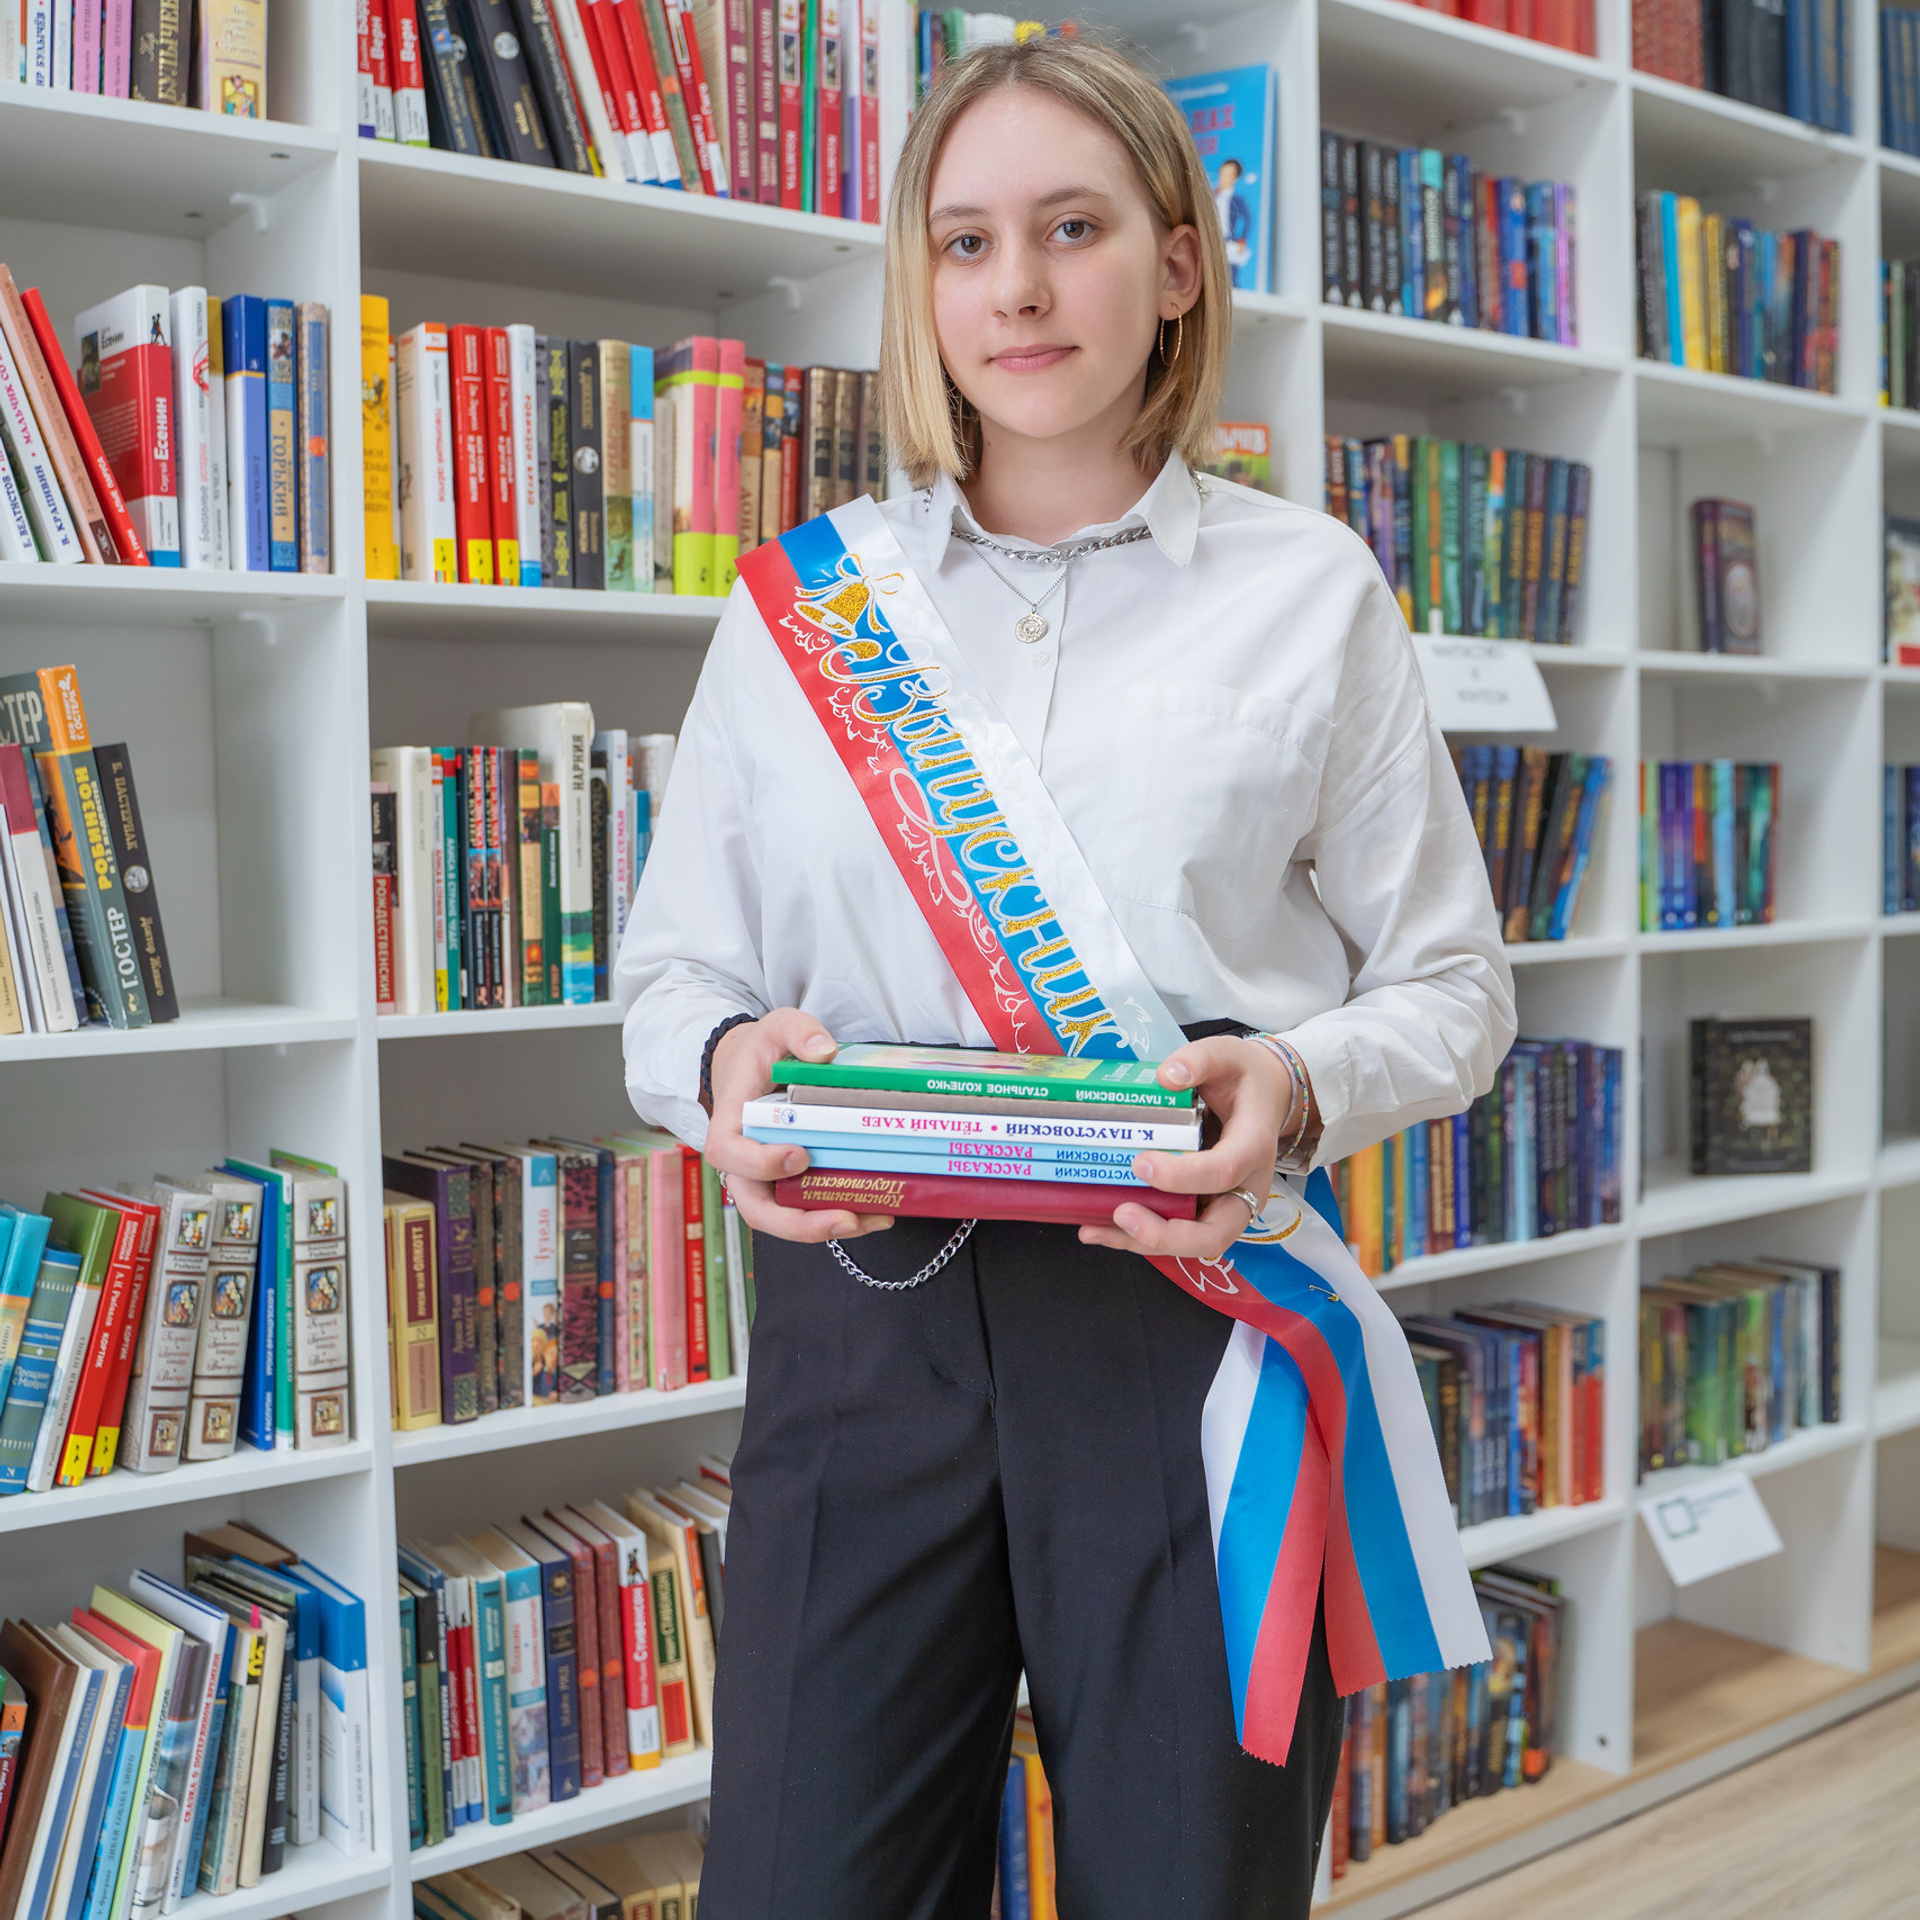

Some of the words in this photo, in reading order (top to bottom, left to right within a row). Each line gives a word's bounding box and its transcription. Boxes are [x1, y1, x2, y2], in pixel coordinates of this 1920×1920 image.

[370, 15, 387, 59] Верн
[399, 16, 418, 62] Верн
[6, 383, 34, 446] МАЛЬЧИК
[152, 397, 170, 461] Есенин
[157, 462, 171, 493] Сергей
[198, 442, 210, 483] истории
[272, 434, 288, 517] ГОРЬКИЙ
[68, 689, 83, 730] ОСТЕРА
[571, 734, 587, 791] НАРНИЯ
[74, 765, 113, 891] РОБИНЗОН
[114, 777, 139, 852] ПАСТЕРНАК
[446, 836, 458, 870] АЛИСА
[819, 637, 1130, 1057] Выпускник
[447, 881, 458, 917] СТРАНЕ
[616, 895, 626, 934] МАЛО
[375, 877, 392, 1001] РОЖДЕСТВЕНСКИЕ
[448, 918, 459, 950] ЧУДЕС
[138, 916, 155, 955] Доктор
[147, 956, 163, 998] Живаго
[926, 1079, 983, 1092] КОЛЕЧКО
[987, 1083, 1050, 1097] СТАЛЬНОЕ
[1075, 1089, 1162, 1105] ПАУСТОВСКИЙ
[1164, 1095, 1176, 1106] К.
[861, 1116, 905, 1129] ХЛЕБ
[910, 1118, 983, 1136] ТЁПЛЫЙ
[1005, 1123, 1132, 1141] ПАУСТОВСКИЙ
[1137, 1129, 1154, 1141] К.
[948, 1159, 1032, 1176] РАССКАЗЫ
[949, 1142, 1034, 1158] РАССКАЗЫ
[801, 1175, 907, 1195] Паустовский
[802, 1189, 905, 1209] Константин
[410, 1229, 425, 1275] ОЛКОТТ
[265, 1288, 275, 1350] ФРАНЦУЗСКОГО
[95, 1331, 111, 1368] КОРТИК
[119, 1324, 133, 1361] КОРТИК
[264, 1391, 274, 1432] РАСПУТИН
[630, 1587, 650, 1663] Стивенсон
[658, 1574, 676, 1636] СТИВЕНСОН
[149, 1741, 163, 1774] ТОМКА
[157, 1688, 172, 1730] СОРОКА
[277, 1674, 296, 1762] СОРОТОКИНА
[183, 1782, 198, 1824] СКАЗКА
[193, 1703, 213, 1770] ПОТЕРЯННОМ
[205, 1654, 222, 1700] ВРЕМЕНИ
[275, 1763, 292, 1804] НИНА
